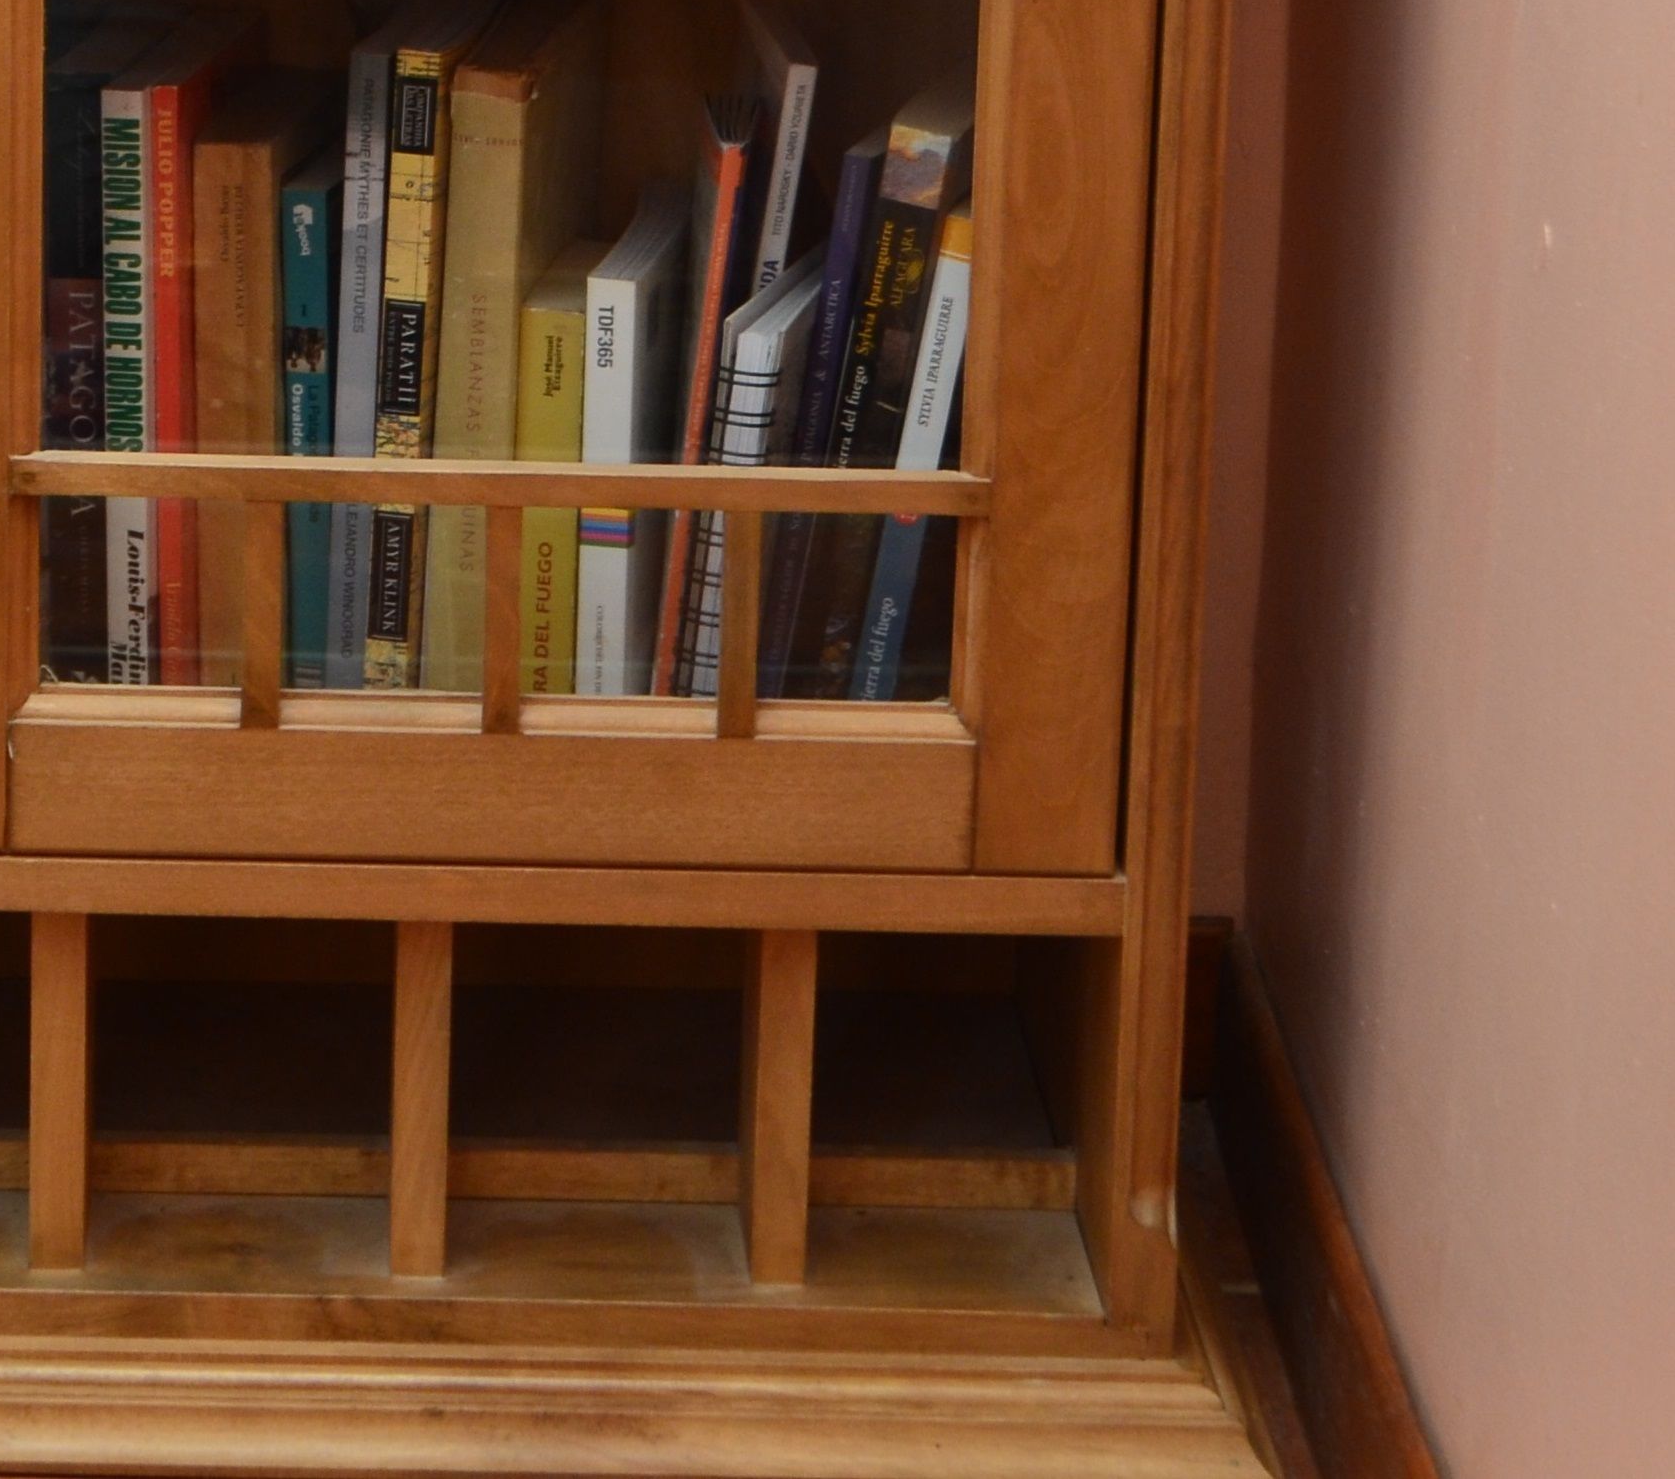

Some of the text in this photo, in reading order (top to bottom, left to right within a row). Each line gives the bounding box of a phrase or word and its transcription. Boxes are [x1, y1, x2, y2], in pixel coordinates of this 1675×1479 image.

[402, 107, 416, 146] LETRAS
[412, 85, 427, 147] COMPANHIA
[155, 108, 177, 277] JULIO POPPER
[770, 214, 783, 235] TITO
[103, 117, 144, 453] MISION AL CABO DE HORNOS
[596, 304, 615, 368] TDF365
[838, 219, 899, 432] del fuego Sylvia Iparraguirre
[291, 383, 303, 446] Osvaldo
[341, 77, 374, 658] PATAGONIE MYTHES CERTITUDES WINOGRAD
[462, 293, 490, 433] SEMBLANZAS
[799, 277, 842, 462] PATAGONIA ANTARCTICA
[916, 295, 956, 427] SYLVIA IPARRAGUIRRE
[125, 529, 147, 684] Louis-Ferdin
[380, 521, 403, 631] AMYR KLINK
[535, 541, 553, 613] FUEGO
[865, 595, 900, 662] del fuego
[533, 621, 550, 658] DEL
